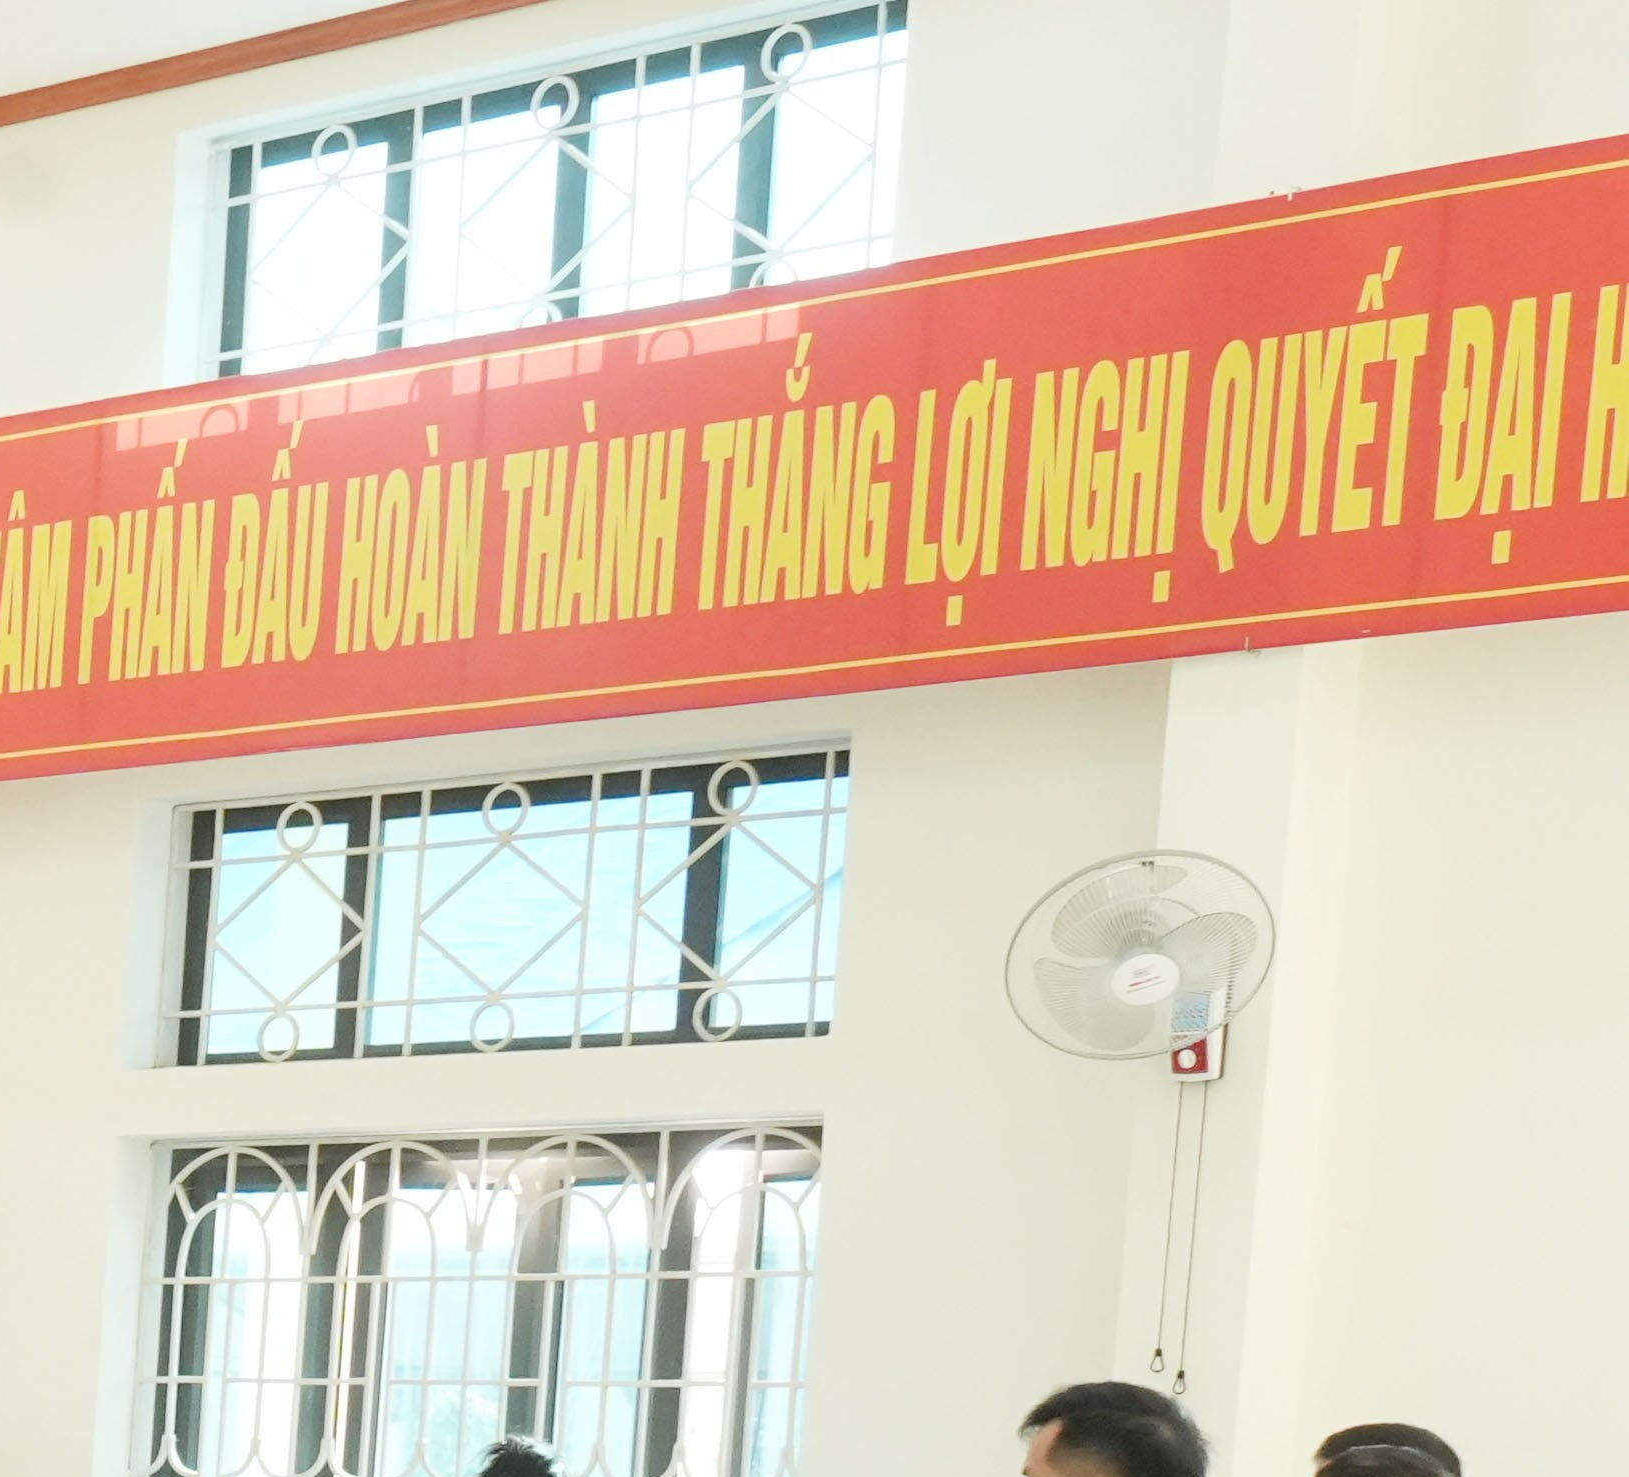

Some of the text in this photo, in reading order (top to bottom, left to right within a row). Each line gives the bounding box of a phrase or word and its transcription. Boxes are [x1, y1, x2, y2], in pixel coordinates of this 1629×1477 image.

[78, 438, 216, 684] PHẤN
[221, 420, 330, 667] ĐẤU
[336, 424, 486, 654] HOÀN
[500, 399, 686, 635] THÀNH
[699, 331, 897, 611] THẮNG
[905, 357, 1014, 627] LỢI
[1020, 350, 1192, 603] NGHỊ
[1201, 245, 1430, 573] QUYẾT
[1434, 291, 1574, 565] ĐẠI
